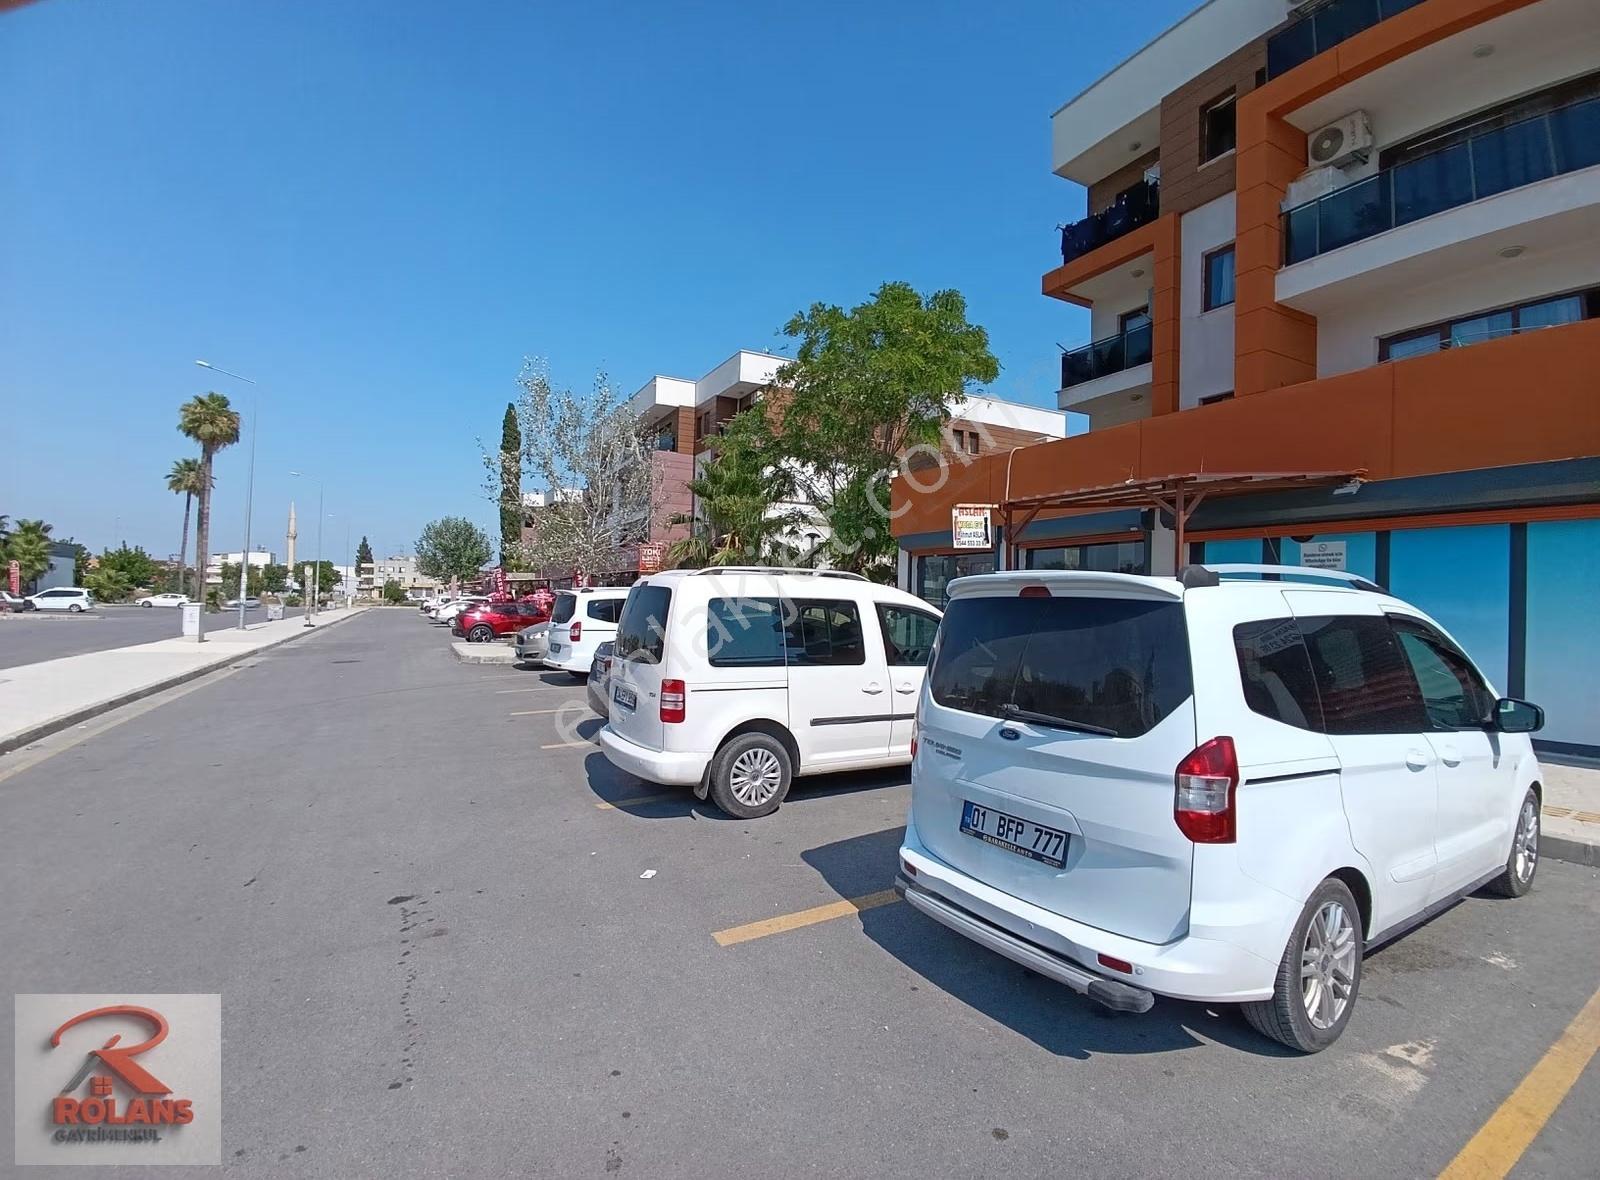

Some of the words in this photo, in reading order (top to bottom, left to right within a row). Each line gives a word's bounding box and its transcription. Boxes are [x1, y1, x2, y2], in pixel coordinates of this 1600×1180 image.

[959, 507, 985, 516] ASLAN
[971, 807, 987, 831] 01
[997, 815, 1025, 842] BFP
[1032, 827, 1064, 857] 777
